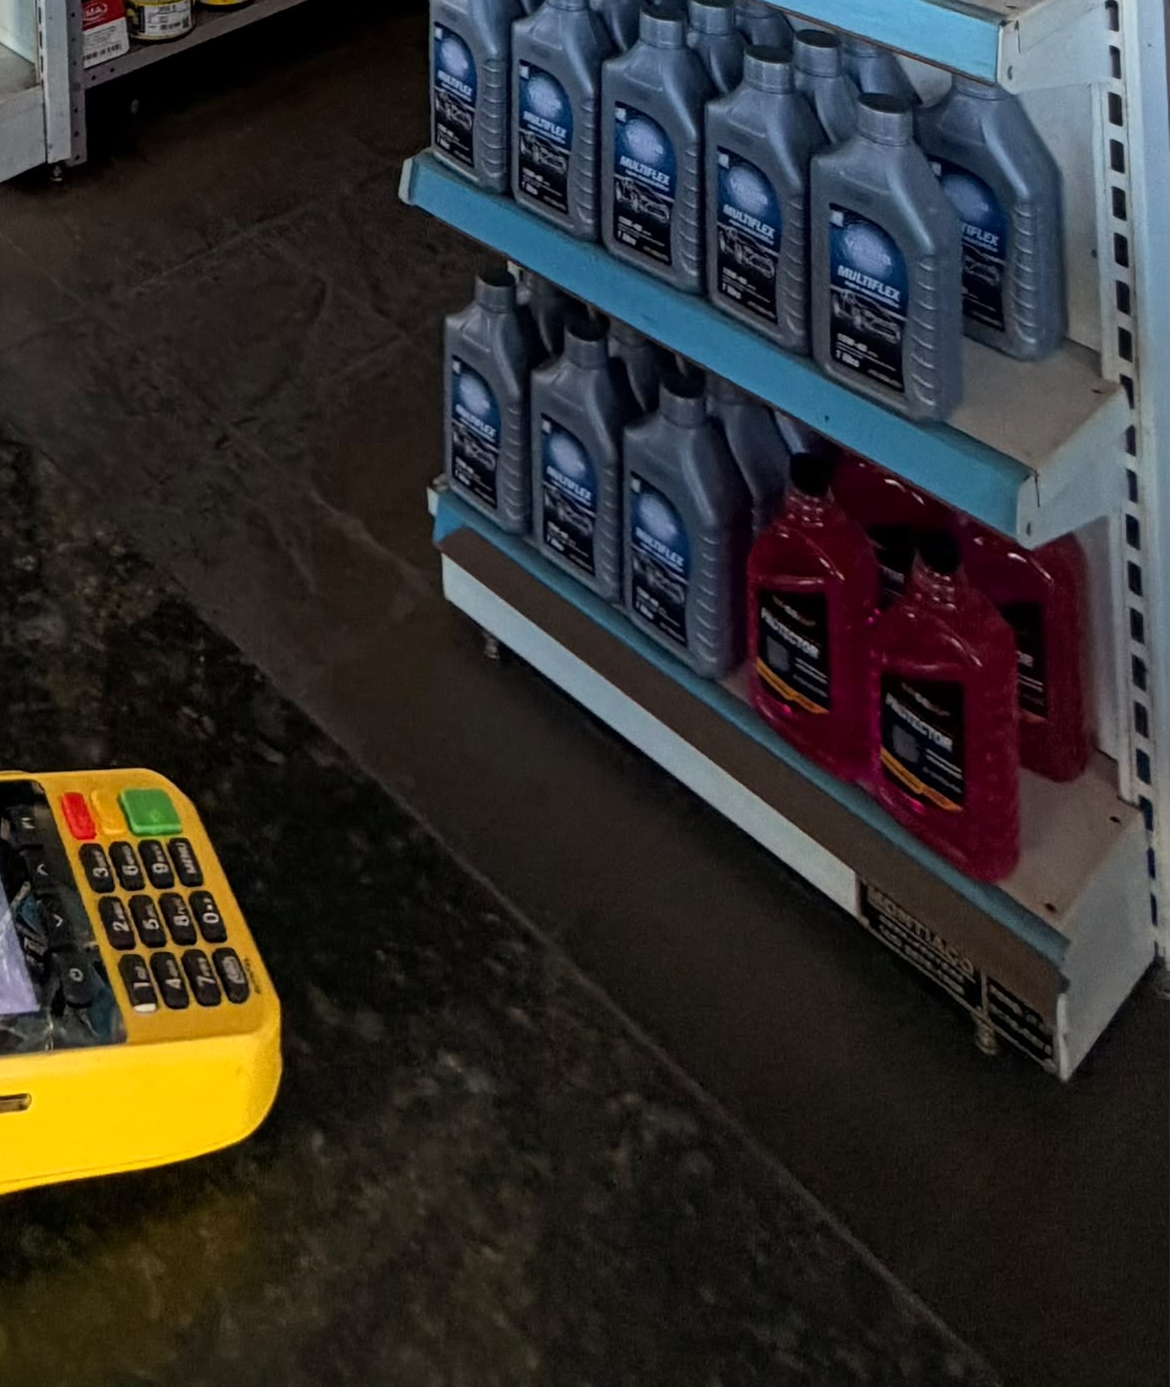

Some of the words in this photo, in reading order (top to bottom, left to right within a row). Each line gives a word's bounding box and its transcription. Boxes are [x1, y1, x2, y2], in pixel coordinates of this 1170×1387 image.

[523, 110, 568, 137] MULTIFLEX
[618, 155, 671, 187] MULTIFLEX
[722, 203, 776, 237] MULTIFLEX
[961, 223, 1000, 246] TIFLEX
[837, 264, 901, 301] MULTIFLEX
[634, 526, 685, 563] MULTIFLEX
[760, 606, 821, 660] PROTECTOR
[885, 691, 953, 753] PROTECTOR
[173, 841, 198, 875] MENU
